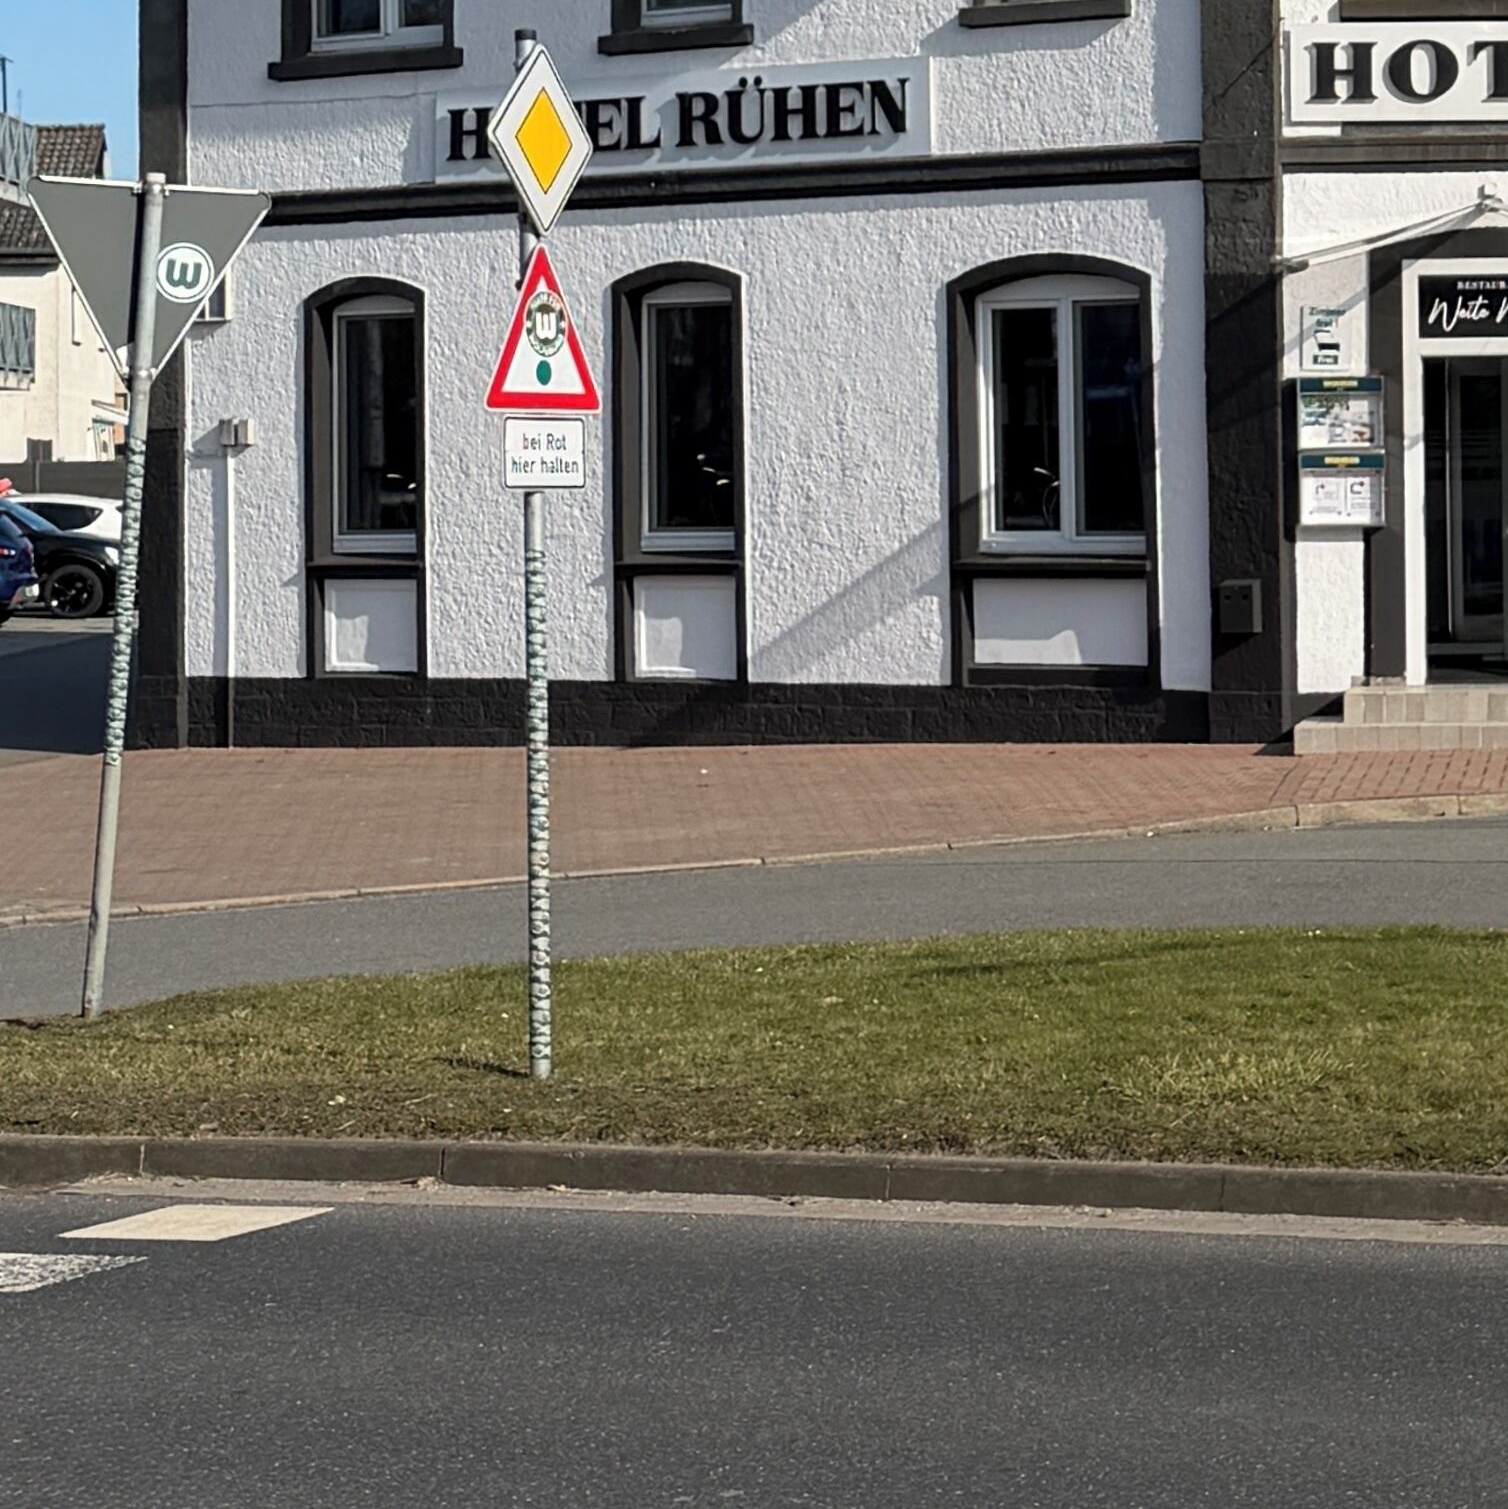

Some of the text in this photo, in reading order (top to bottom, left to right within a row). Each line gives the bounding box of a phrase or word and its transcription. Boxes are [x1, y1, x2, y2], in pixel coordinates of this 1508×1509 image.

[446, 76, 910, 161] HEL RÜHEN
[1427, 295, 1490, 332] Weite
[522, 432, 567, 451] bei Rot
[511, 455, 580, 473] hier halten
